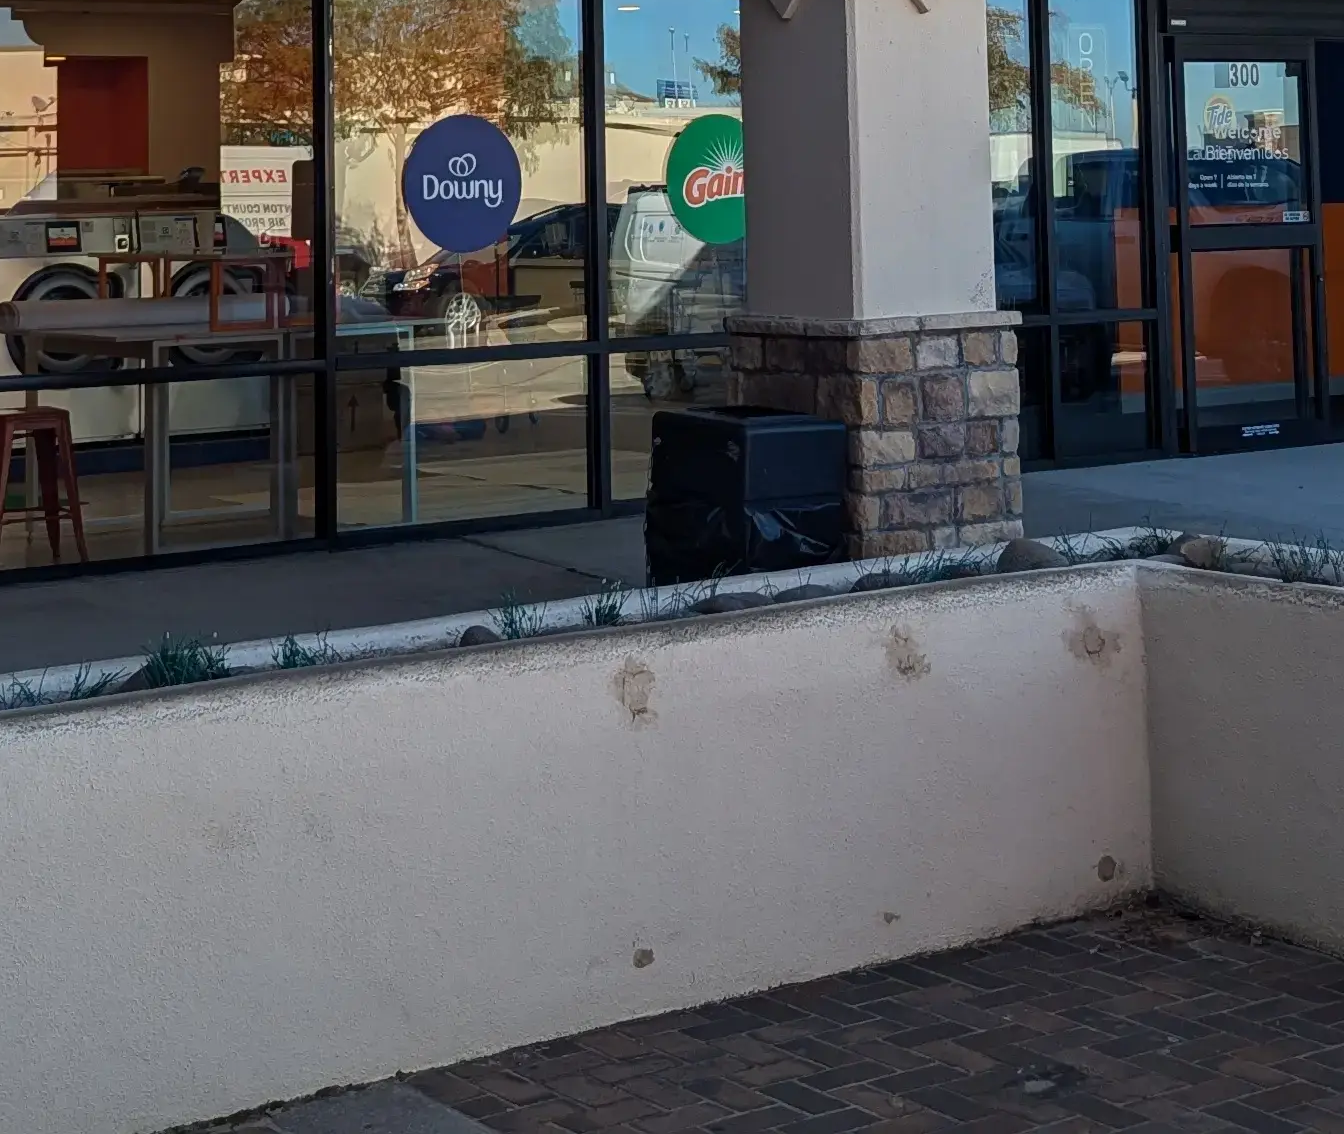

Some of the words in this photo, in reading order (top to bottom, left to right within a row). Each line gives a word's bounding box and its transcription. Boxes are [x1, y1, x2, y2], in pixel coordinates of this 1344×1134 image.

[1078, 32, 1096, 130] OPEN
[1229, 63, 1260, 87] 300
[1205, 105, 1233, 128] Tide
[1212, 125, 1282, 140] Welcome
[1205, 145, 1289, 161] Bienvenidos
[422, 174, 504, 208] Downy
